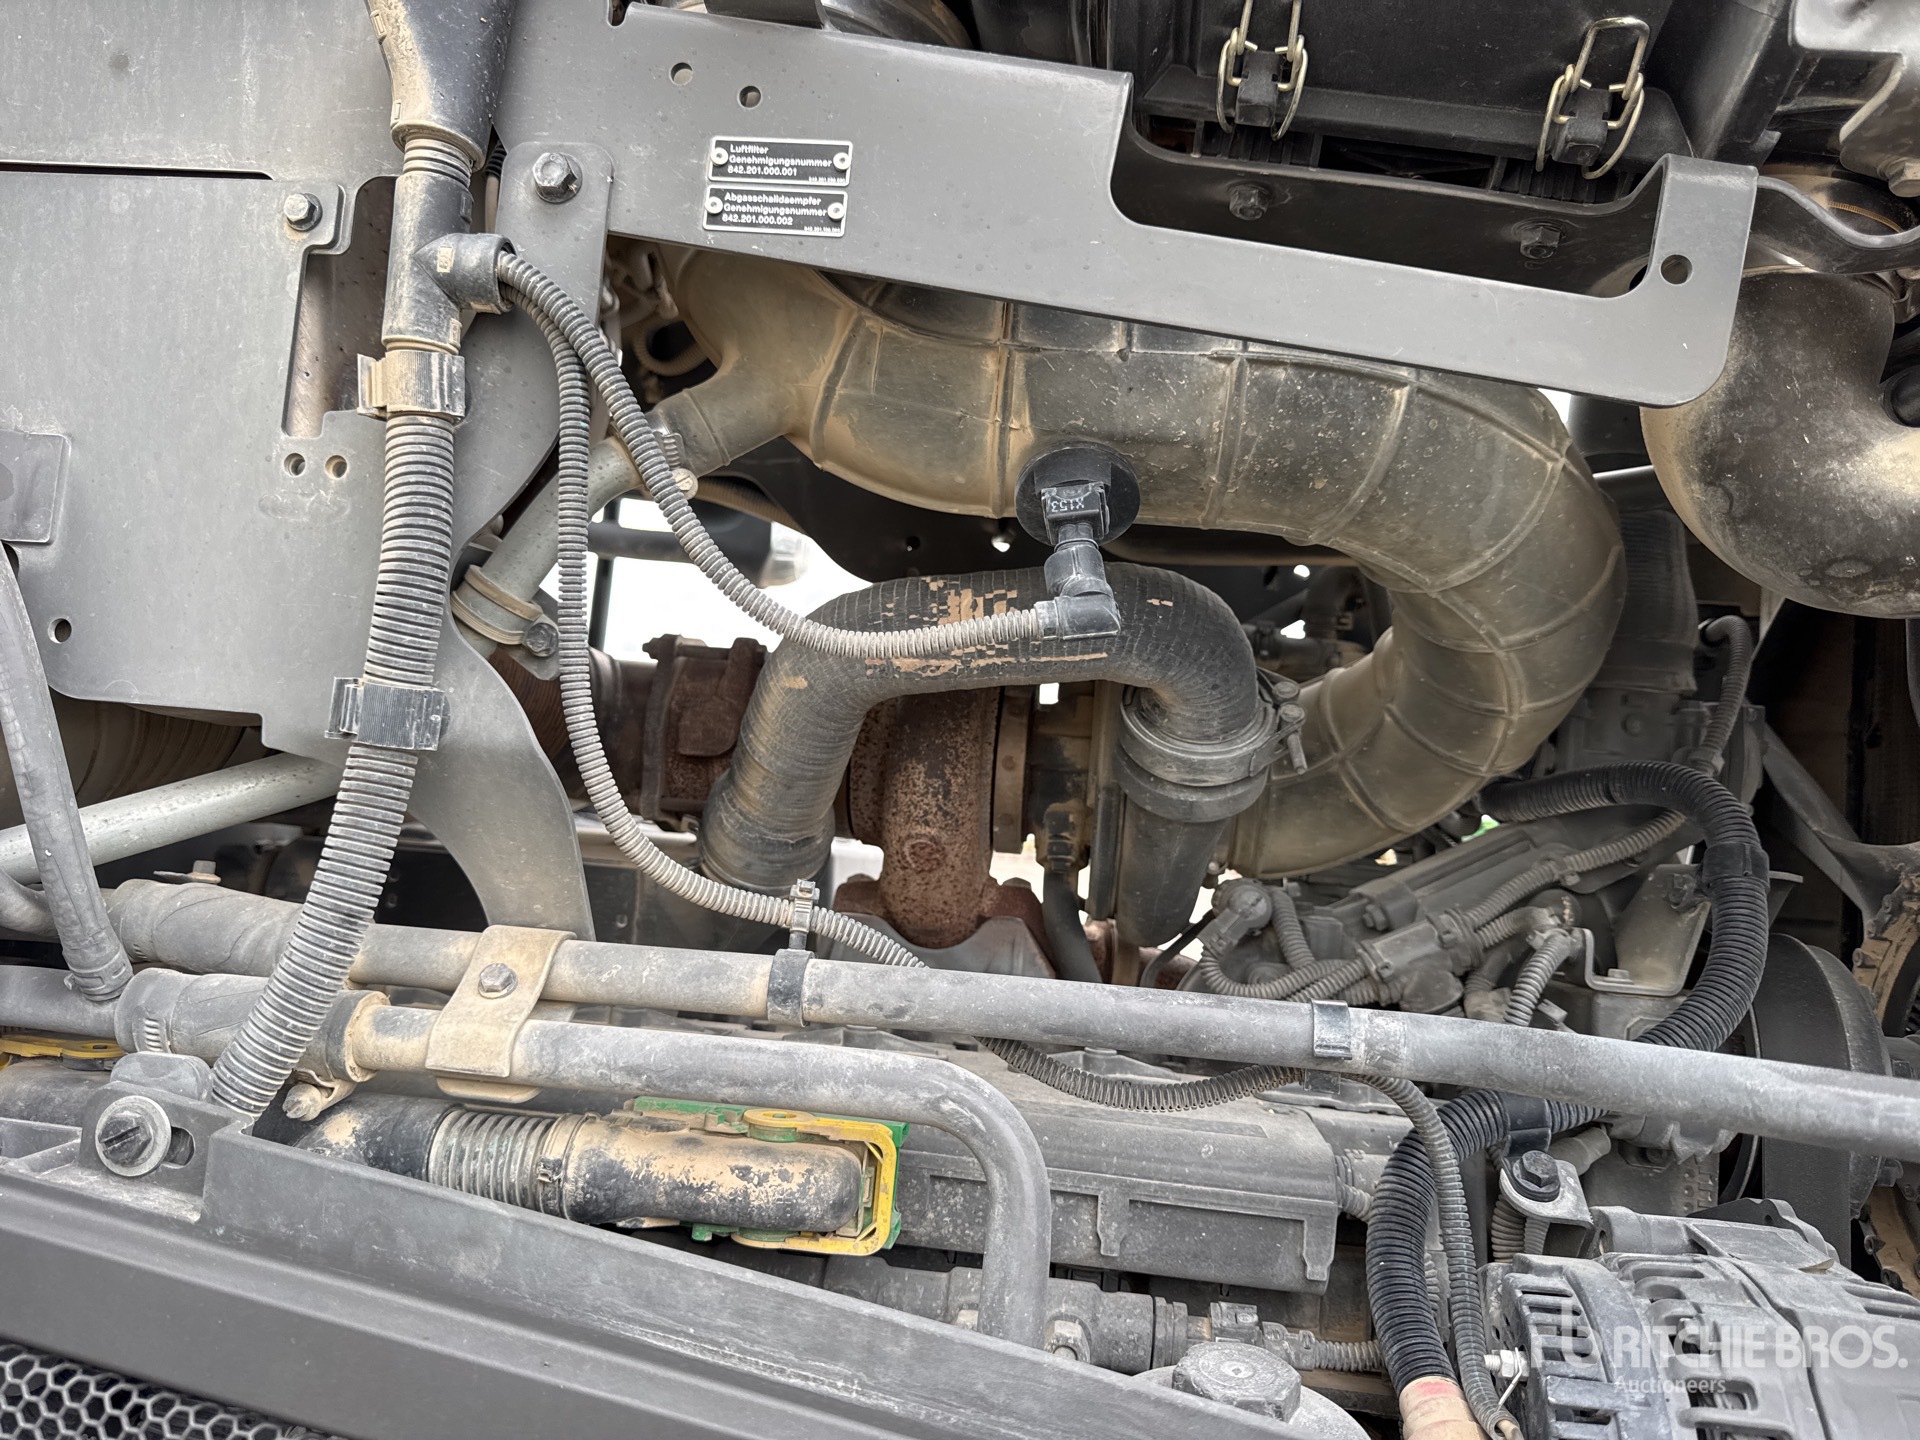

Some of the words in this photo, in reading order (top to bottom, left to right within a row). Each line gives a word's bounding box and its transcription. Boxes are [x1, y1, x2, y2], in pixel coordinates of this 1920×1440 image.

[730, 144, 769, 154] Luftfilter
[729, 155, 832, 167] Genehmigungsnummer
[727, 165, 797, 176] 842.201.000.001
[724, 192, 822, 206] Abgasschalldaempfer
[723, 203, 827, 217] Genehmigungsnummer
[722, 214, 793, 225] 842.201.000.002
[1051, 497, 1085, 512] X153
